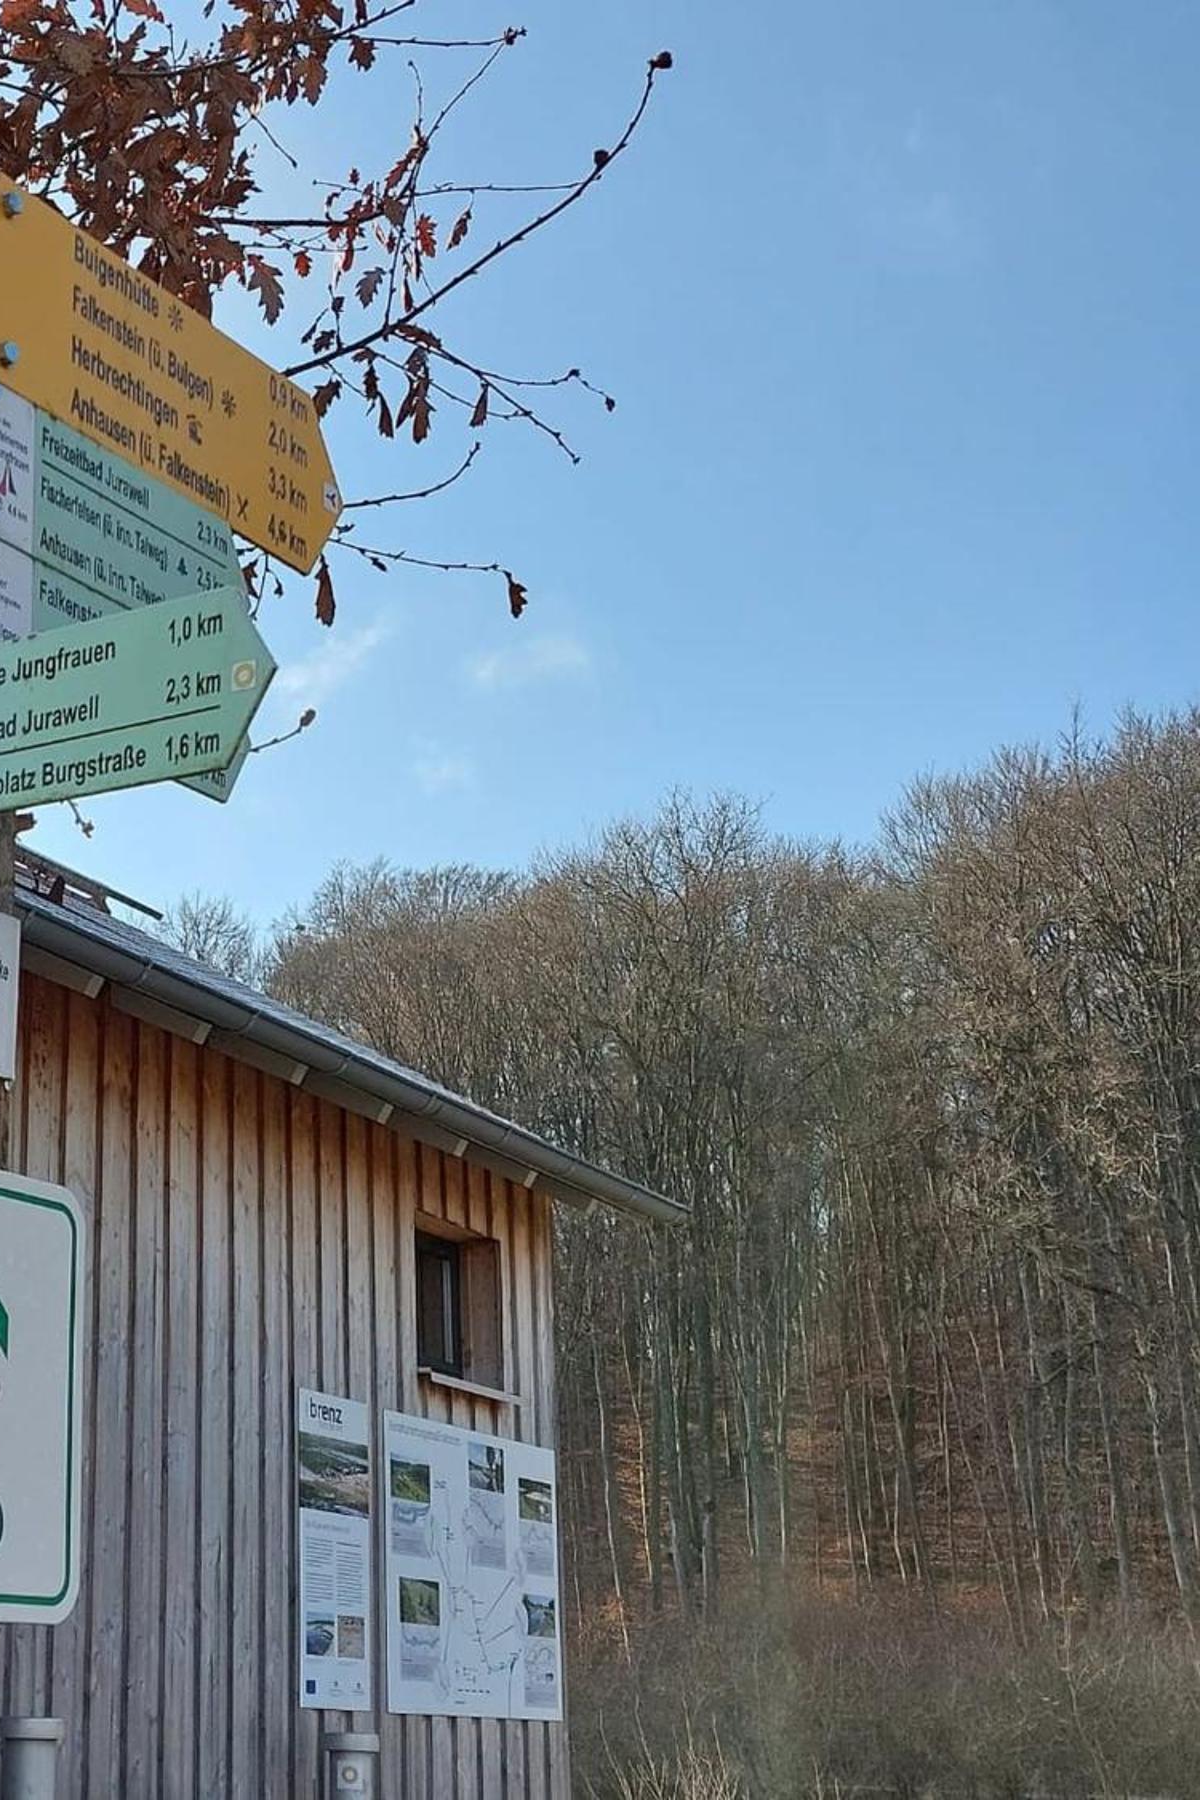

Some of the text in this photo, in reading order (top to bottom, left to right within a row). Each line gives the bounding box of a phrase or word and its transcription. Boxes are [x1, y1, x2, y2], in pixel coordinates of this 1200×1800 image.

[72, 285, 145, 358] Falkenstein
[268, 421, 287, 456] 2,0
[290, 435, 308, 469] km
[269, 375, 287, 408] 0,9
[290, 388, 308, 423] km
[71, 335, 308, 514] Herbrechtingen 3,3 km
[42, 426, 103, 485] Freizeitbad
[105, 467, 150, 511] Jurawell
[213, 533, 228, 556] km
[71, 387, 136, 453] Anhausen
[159, 444, 230, 519] Falkenstein)
[290, 525, 308, 560] km
[40, 527, 91, 574] Anhausen
[11, 640, 116, 682] Jungfrauen
[168, 616, 192, 647] 1,0
[197, 613, 223, 637] km
[22, 694, 99, 735] Jurawell
[165, 675, 190, 705] 2,3
[196, 671, 221, 696] km
[42, 745, 146, 787] Burgstraße
[165, 734, 189, 765] 1,6
[194, 731, 220, 755] km
[309, 1396, 343, 1424] brenz
